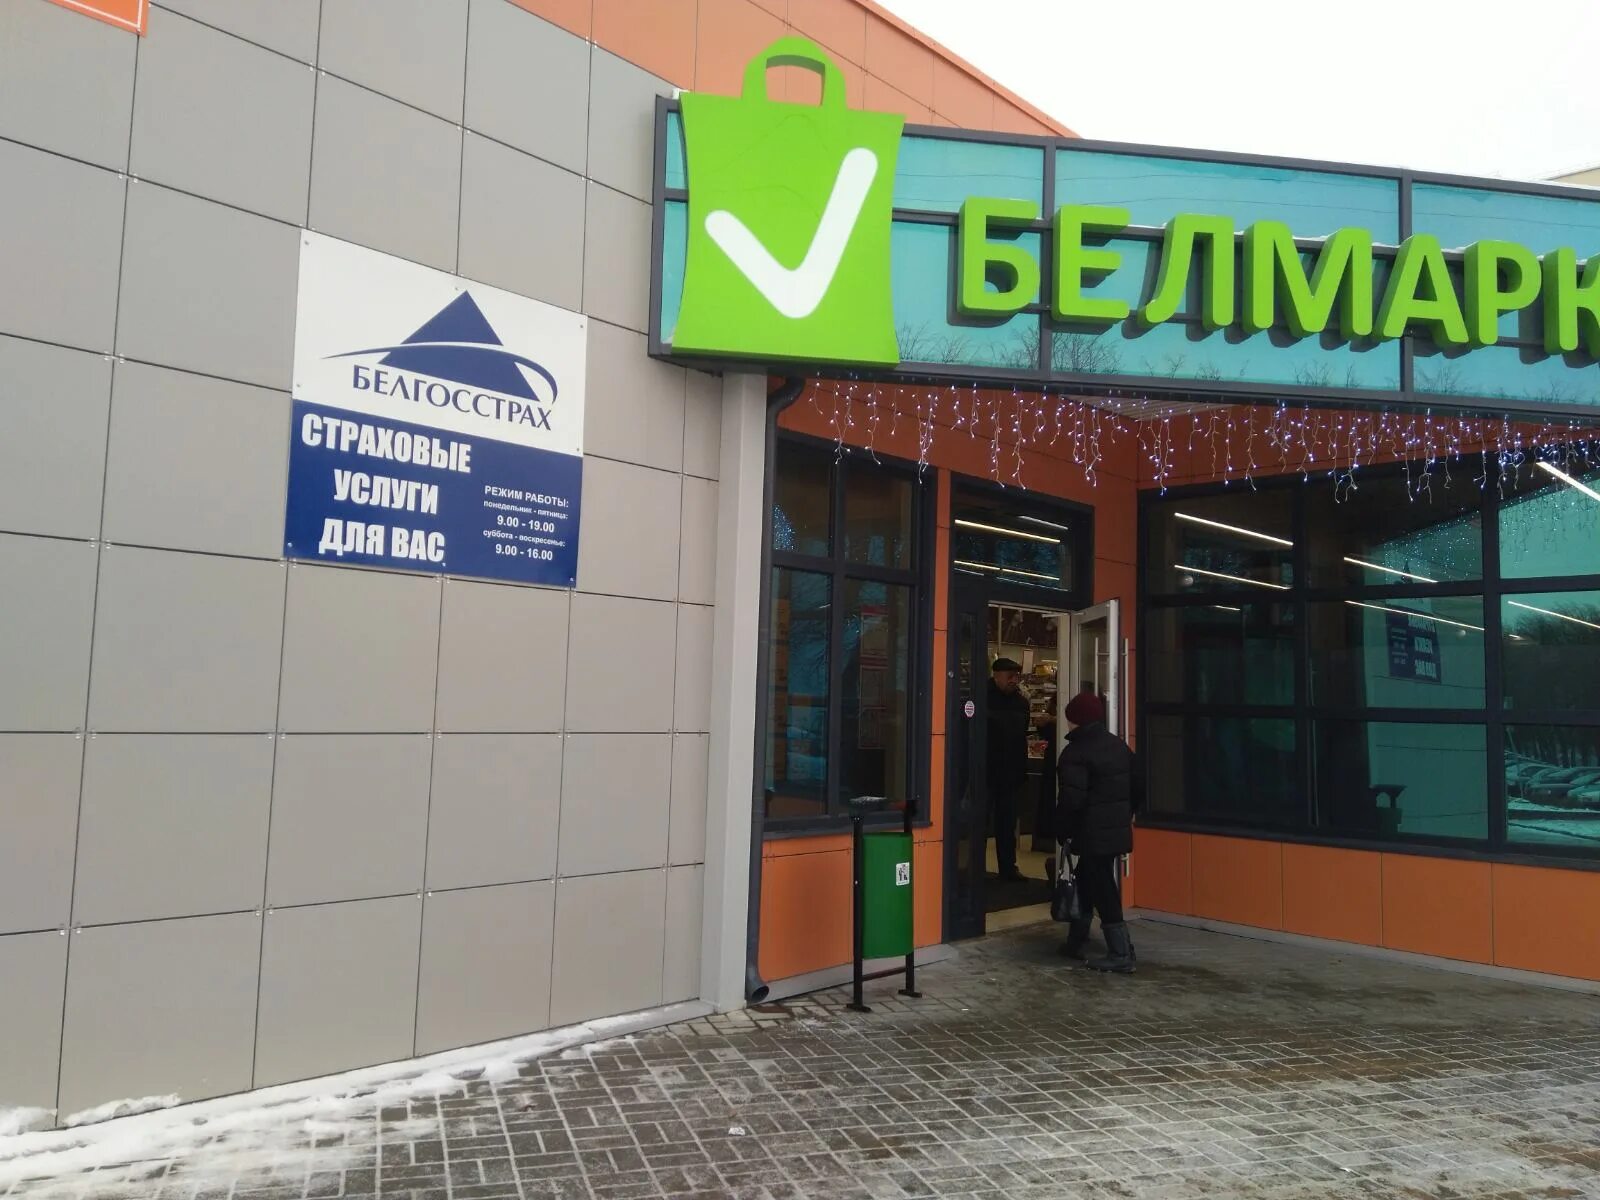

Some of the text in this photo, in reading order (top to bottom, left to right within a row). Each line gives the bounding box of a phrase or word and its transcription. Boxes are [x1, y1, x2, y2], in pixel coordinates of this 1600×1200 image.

[958, 197, 1600, 355] БЕЛМАРК
[353, 364, 551, 431] БЕЛГОССТРАХ
[302, 413, 471, 473] СТРАХОВЫЕ
[333, 469, 439, 514] УСЛУГИ
[483, 500, 532, 514] понедельник
[484, 485, 569, 508] РЕЖИМ РАБОТЫ:
[318, 518, 445, 562] ДЛЯ ВАС
[483, 530, 513, 540] суббота
[497, 515, 519, 528] 9.00
[528, 520, 555, 533] 19.00
[495, 544, 517, 556] 9.00
[527, 548, 553, 561] 16.00
